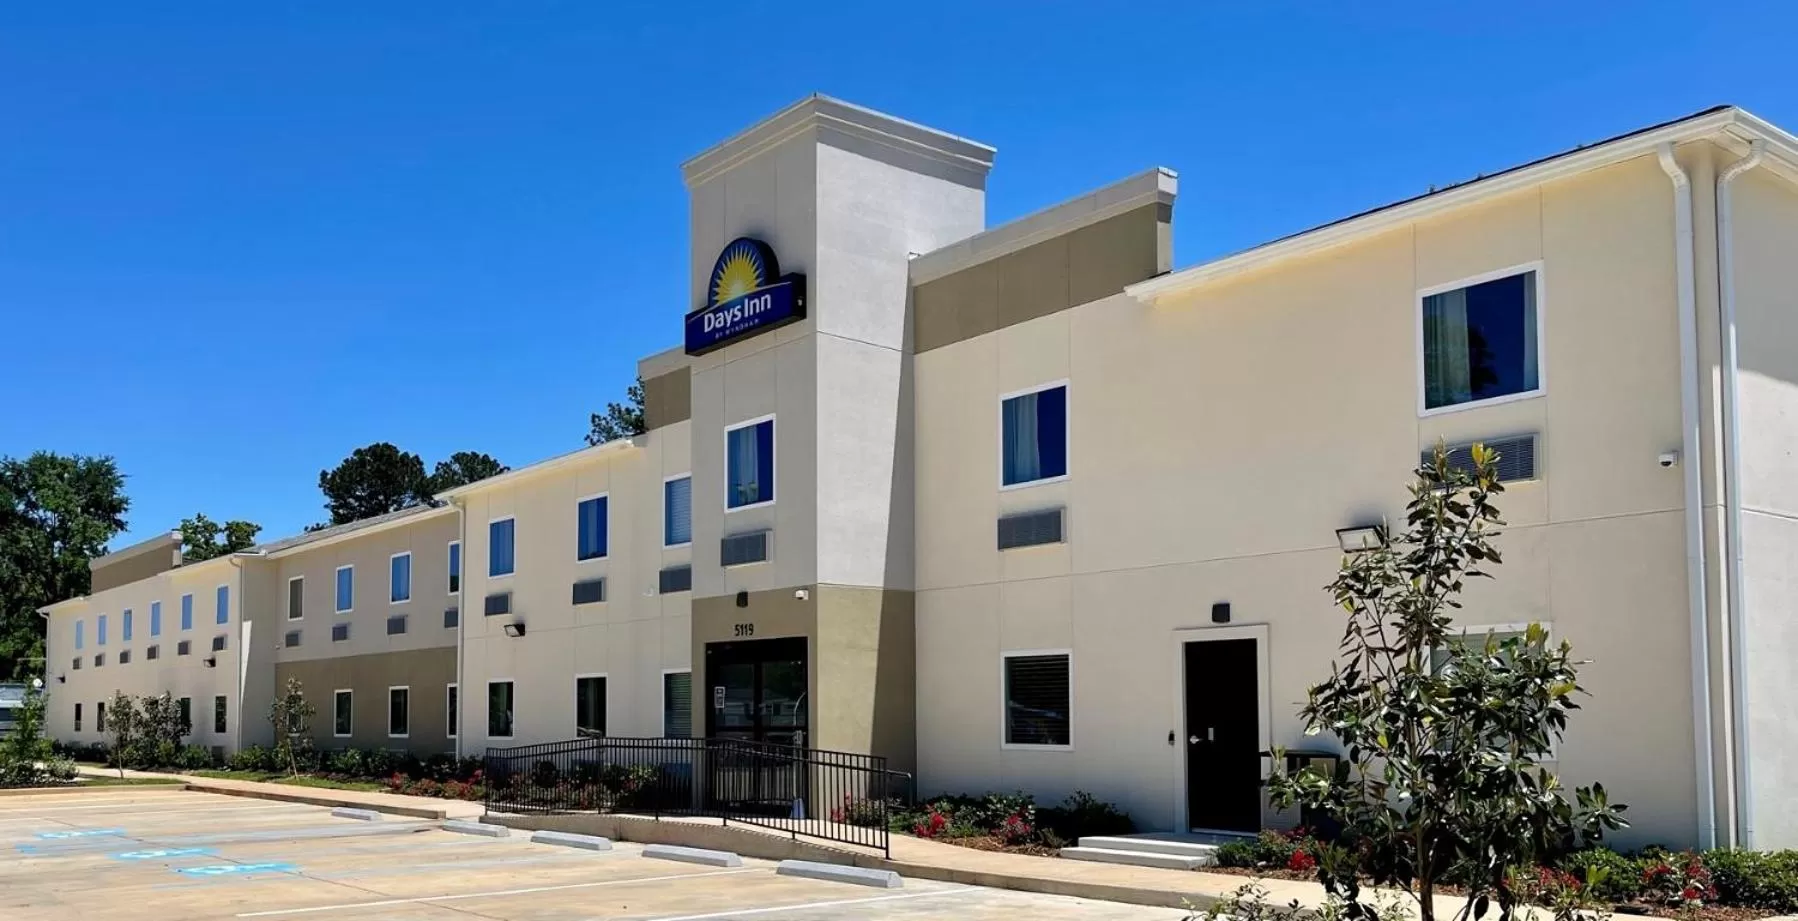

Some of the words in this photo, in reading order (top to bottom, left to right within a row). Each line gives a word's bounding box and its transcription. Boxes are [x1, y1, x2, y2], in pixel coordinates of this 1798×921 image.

[704, 305, 742, 333] Days
[744, 294, 771, 318] Inn
[735, 623, 754, 636] 5119
